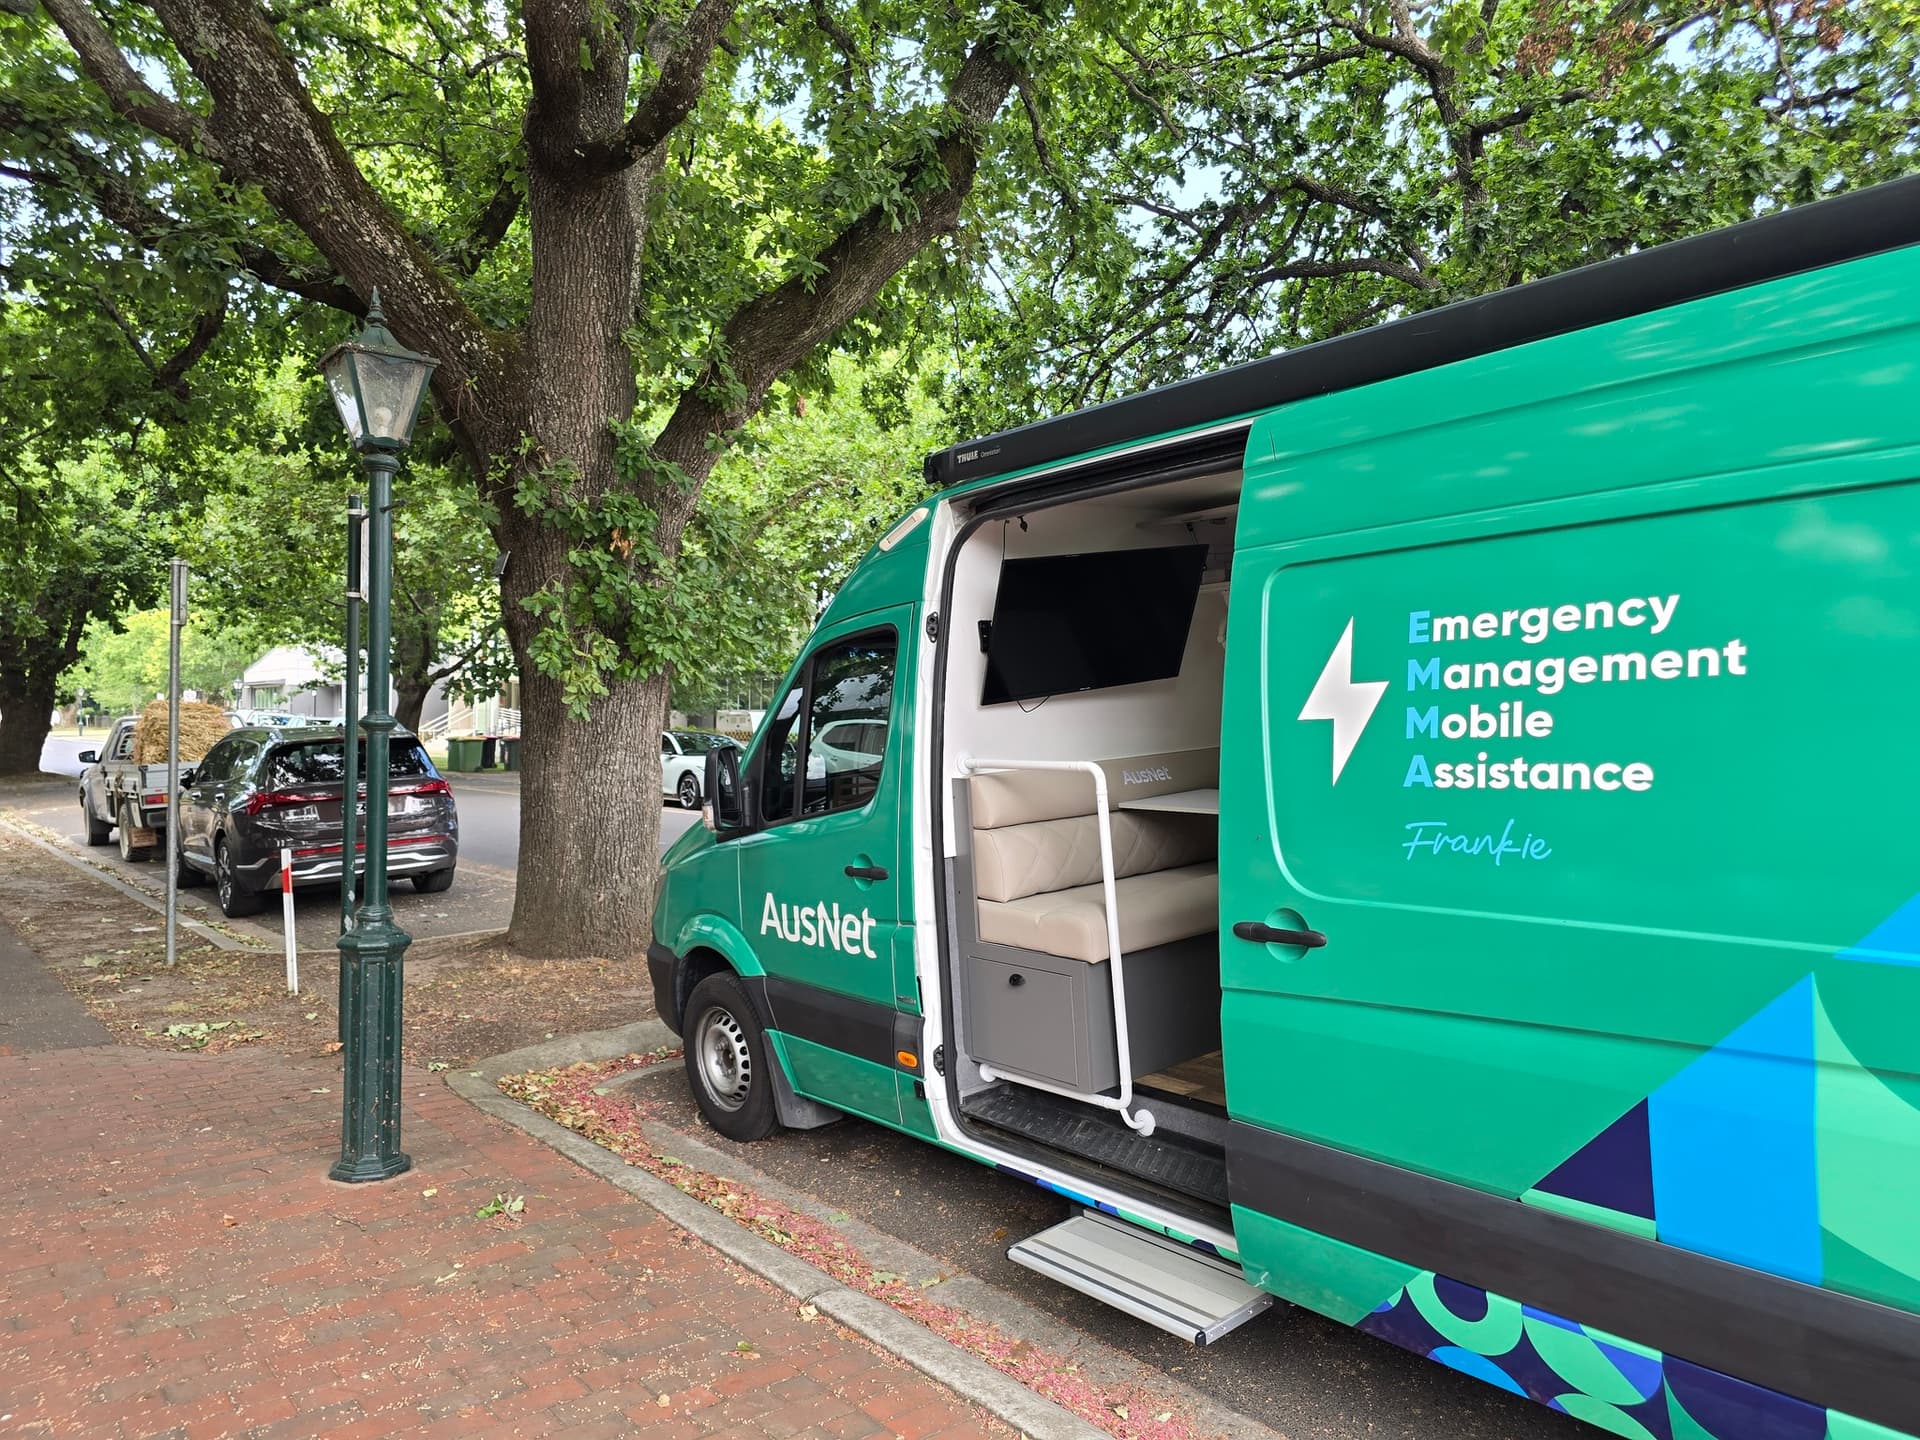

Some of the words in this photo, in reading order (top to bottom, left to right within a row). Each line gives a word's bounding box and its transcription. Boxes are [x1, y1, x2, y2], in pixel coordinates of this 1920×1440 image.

[957, 450, 979, 464] THULE
[1408, 594, 1680, 644] Emergency
[1407, 639, 1747, 694] Management
[1405, 701, 1554, 739] Mobile
[1122, 766, 1172, 785] AusNet
[1403, 751, 1654, 791] Assistance
[1402, 819, 1552, 866] Frankie
[760, 891, 877, 959] AusNet
